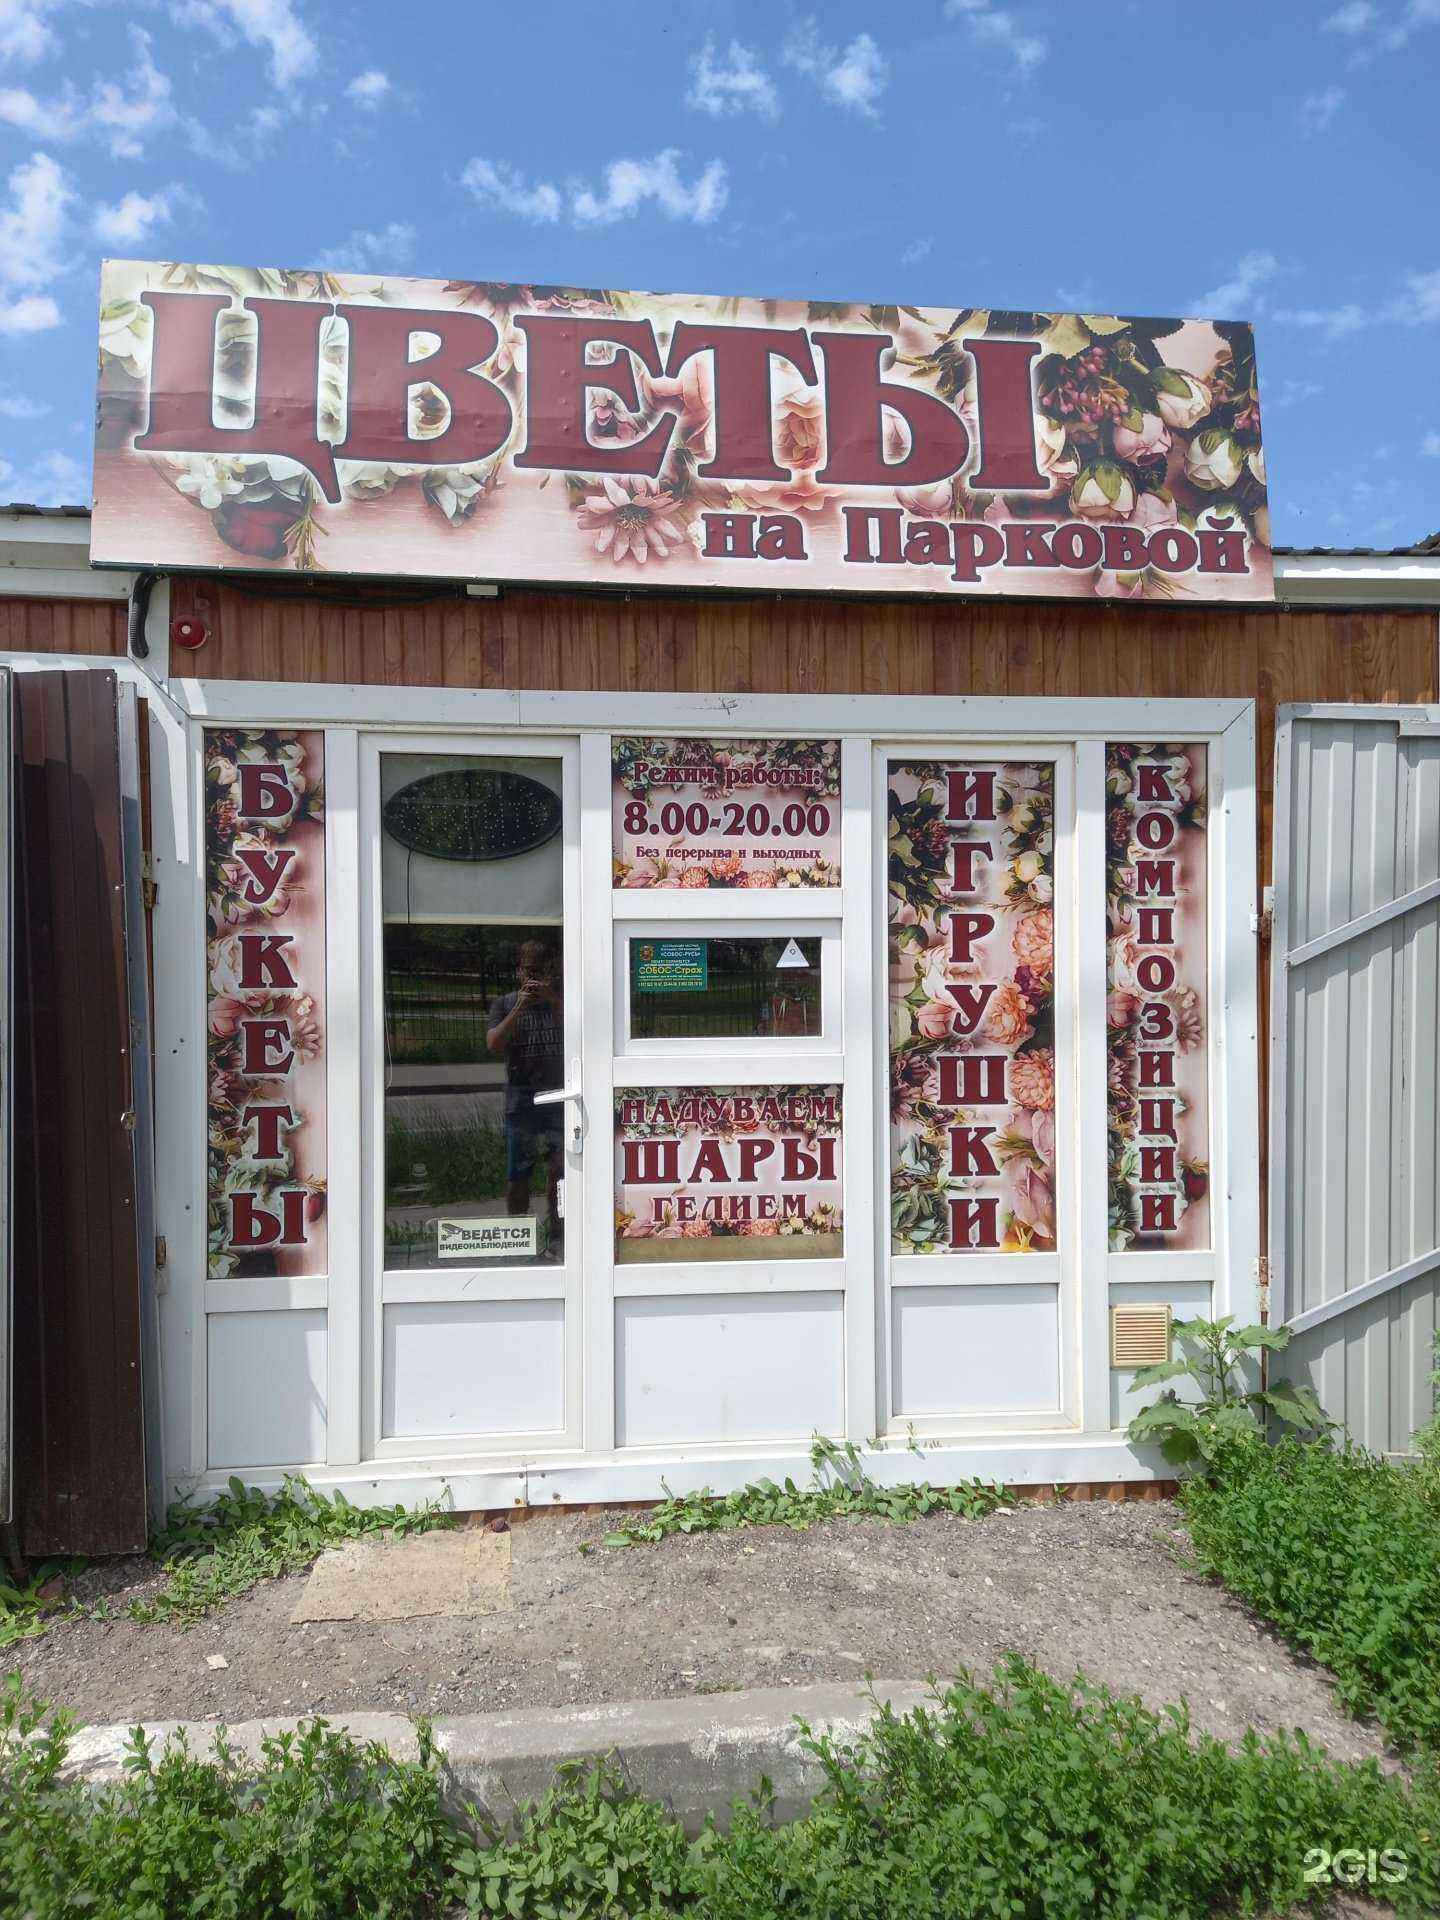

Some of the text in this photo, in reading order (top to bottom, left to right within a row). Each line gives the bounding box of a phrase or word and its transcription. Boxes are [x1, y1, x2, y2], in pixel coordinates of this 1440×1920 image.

[134, 289, 1051, 505] ЦВЕТЫ
[699, 506, 1250, 583] на Парковой
[633, 760, 823, 788] Режим работы:
[623, 801, 831, 837] 8.00-20.00
[635, 845, 660, 858] Без
[666, 848, 732, 860] перерыва
[752, 848, 822, 860] выходных
[227, 763, 308, 1247] БУКЕТЫ
[936, 770, 1009, 1249] ИГРУШКИ
[1136, 764, 1178, 1232] КОМПОЗИЦИИ
[622, 1096, 836, 1127] НАДУВАЕМ
[621, 1138, 837, 1184] ШАРЫ
[652, 1194, 807, 1222] ГЕЛИЕМ
[439, 1240, 531, 1251] ВИДЕОНАБЛЮДЕНИЕ
[461, 1226, 531, 1241] ВЕДЁТСЯ
